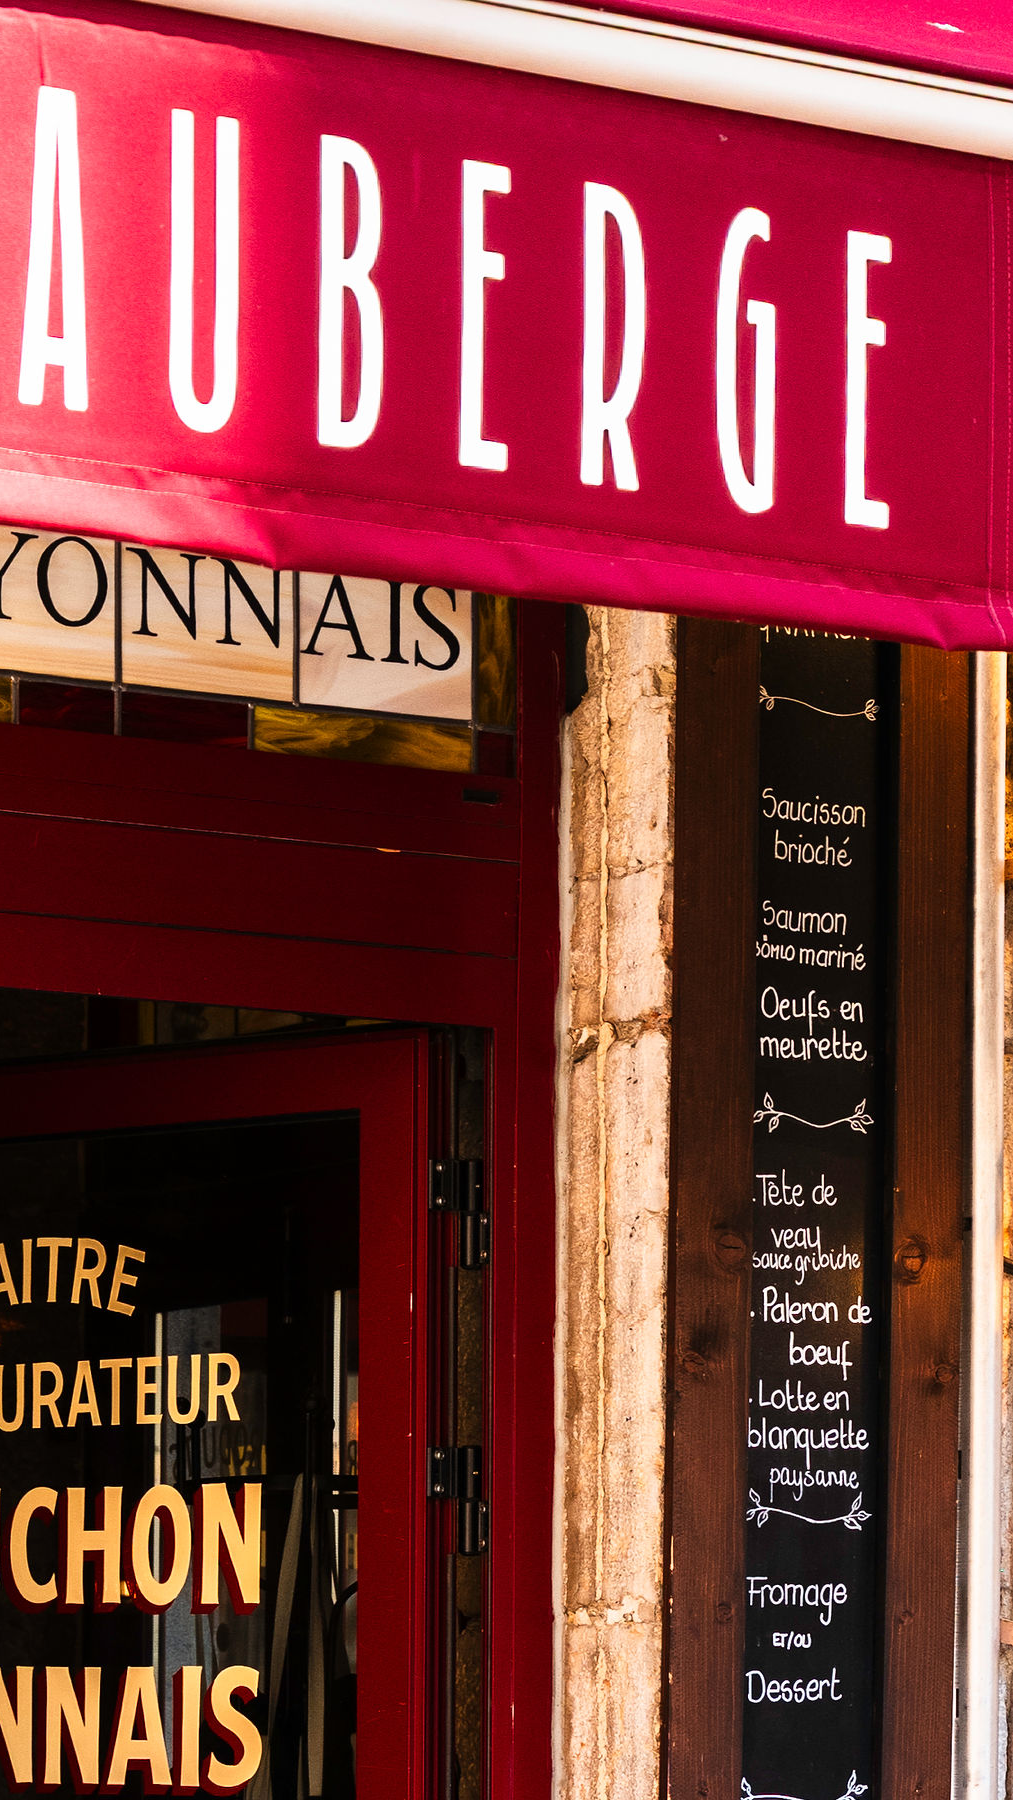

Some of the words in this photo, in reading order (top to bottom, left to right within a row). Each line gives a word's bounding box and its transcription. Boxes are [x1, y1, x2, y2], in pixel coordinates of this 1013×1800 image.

[762, 787, 866, 828] Saucisson
[774, 829, 852, 867] brioché
[762, 900, 847, 935] Saumon
[799, 944, 866, 971] mariné
[761, 986, 830, 1036] Oeufs
[840, 1000, 863, 1023] en
[760, 1028, 867, 1062] meurette
[756, 1169, 804, 1206] Tête
[812, 1174, 837, 1206] de
[771, 1226, 821, 1250] veau
[752, 1251, 792, 1269] sauce
[795, 1245, 861, 1285] gribiche
[763, 1285, 838, 1324] Paleron
[848, 1296, 872, 1324] de
[789, 1331, 853, 1381] boeuf
[758, 1379, 821, 1412] Lotte
[823, 1390, 849, 1411] en
[747, 1417, 869, 1470] blanquette
[770, 1466, 860, 1503] paysanne
[746, 1576, 848, 1625] Fromage
[772, 1631, 812, 1650] ET/OU
[745, 1667, 843, 1704] Dessert
